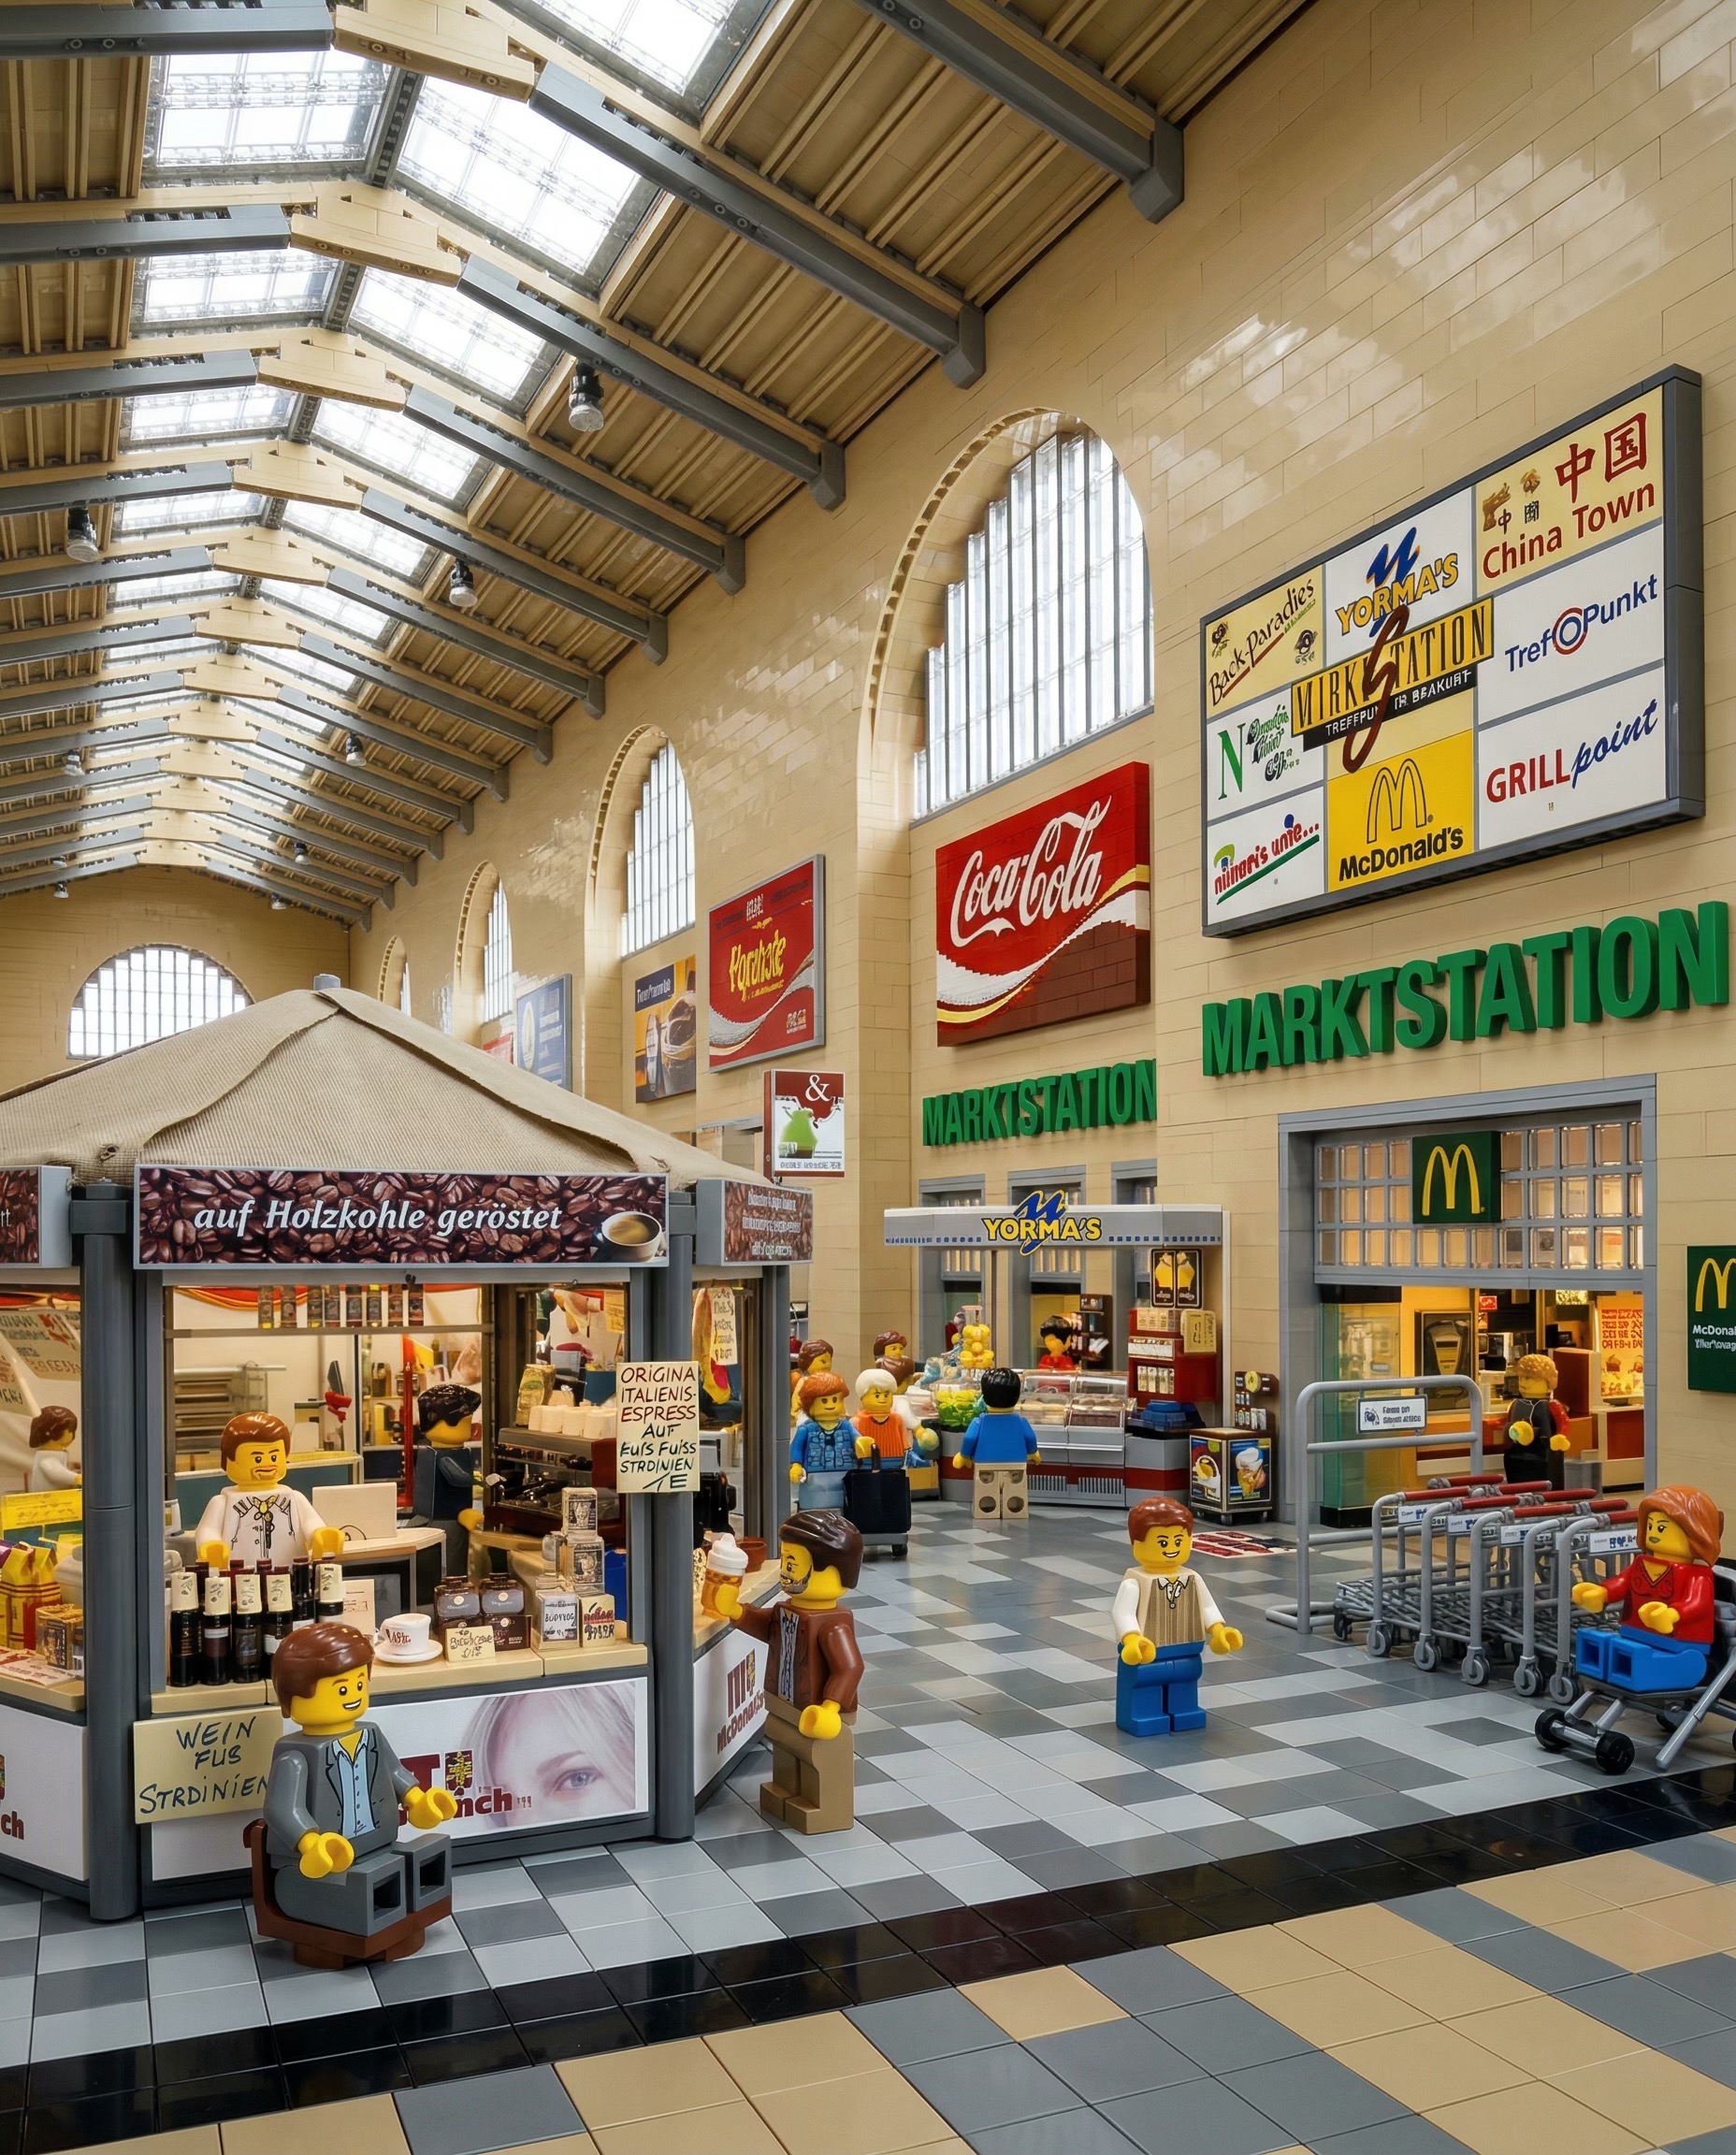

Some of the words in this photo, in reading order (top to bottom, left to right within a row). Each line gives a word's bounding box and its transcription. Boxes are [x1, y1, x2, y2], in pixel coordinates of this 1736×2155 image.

[1555, 412, 1647, 503] 中国
[1483, 526, 1563, 579] China
[1571, 483, 1656, 540] Town
[1335, 552, 1459, 636] YORMA'S
[1208, 578, 1315, 706] Back-Paradies
[1325, 705, 1379, 736] TREFFPU
[1486, 748, 1571, 803] GRILL
[1570, 699, 1658, 789] point
[950, 795, 1112, 947] Coca-Cola
[1338, 826, 1465, 882] McDonald's
[1203, 901, 1729, 1077] MARKTSTATION
[922, 1058, 1157, 1147] MARKTSTATION
[194, 1200, 255, 1237] auf
[266, 1198, 426, 1230] Holzkohle
[437, 1200, 563, 1237] geröstet
[981, 1217, 1103, 1241] YORMA'S
[620, 1405, 697, 1424] ESPRESS
[176, 1715, 257, 1750] WEIN
